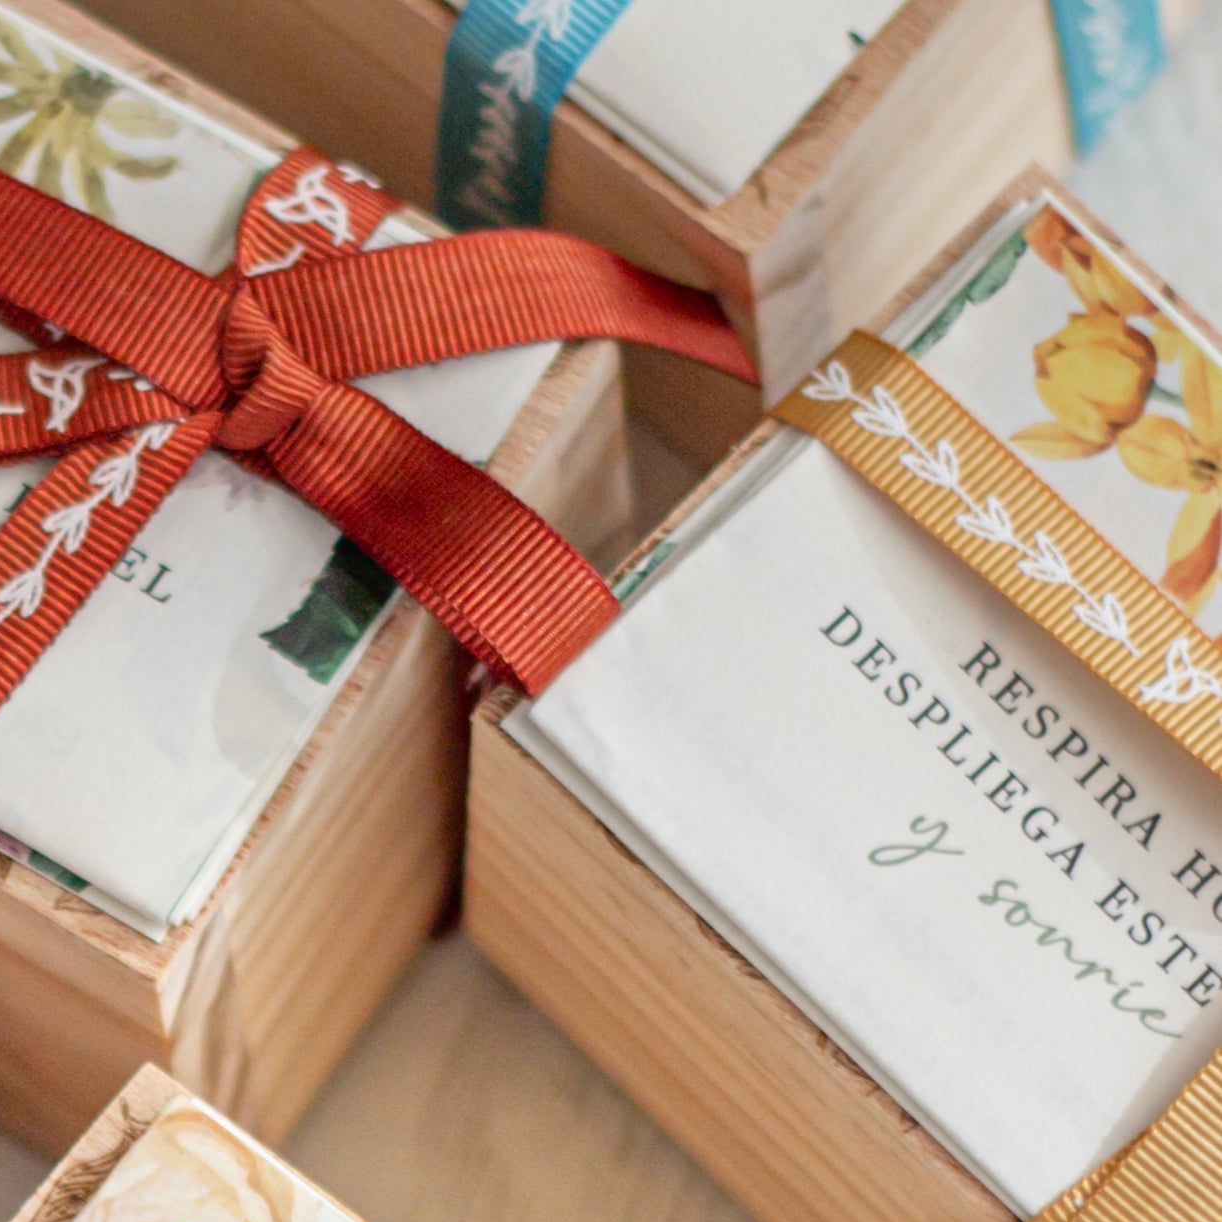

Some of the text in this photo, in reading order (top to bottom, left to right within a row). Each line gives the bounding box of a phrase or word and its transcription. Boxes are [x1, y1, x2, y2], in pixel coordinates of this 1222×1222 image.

[818, 604, 1222, 1008] DESPLIEGA ESTE
[867, 815, 966, 868] y
[958, 642, 1164, 852] RESPIRA
